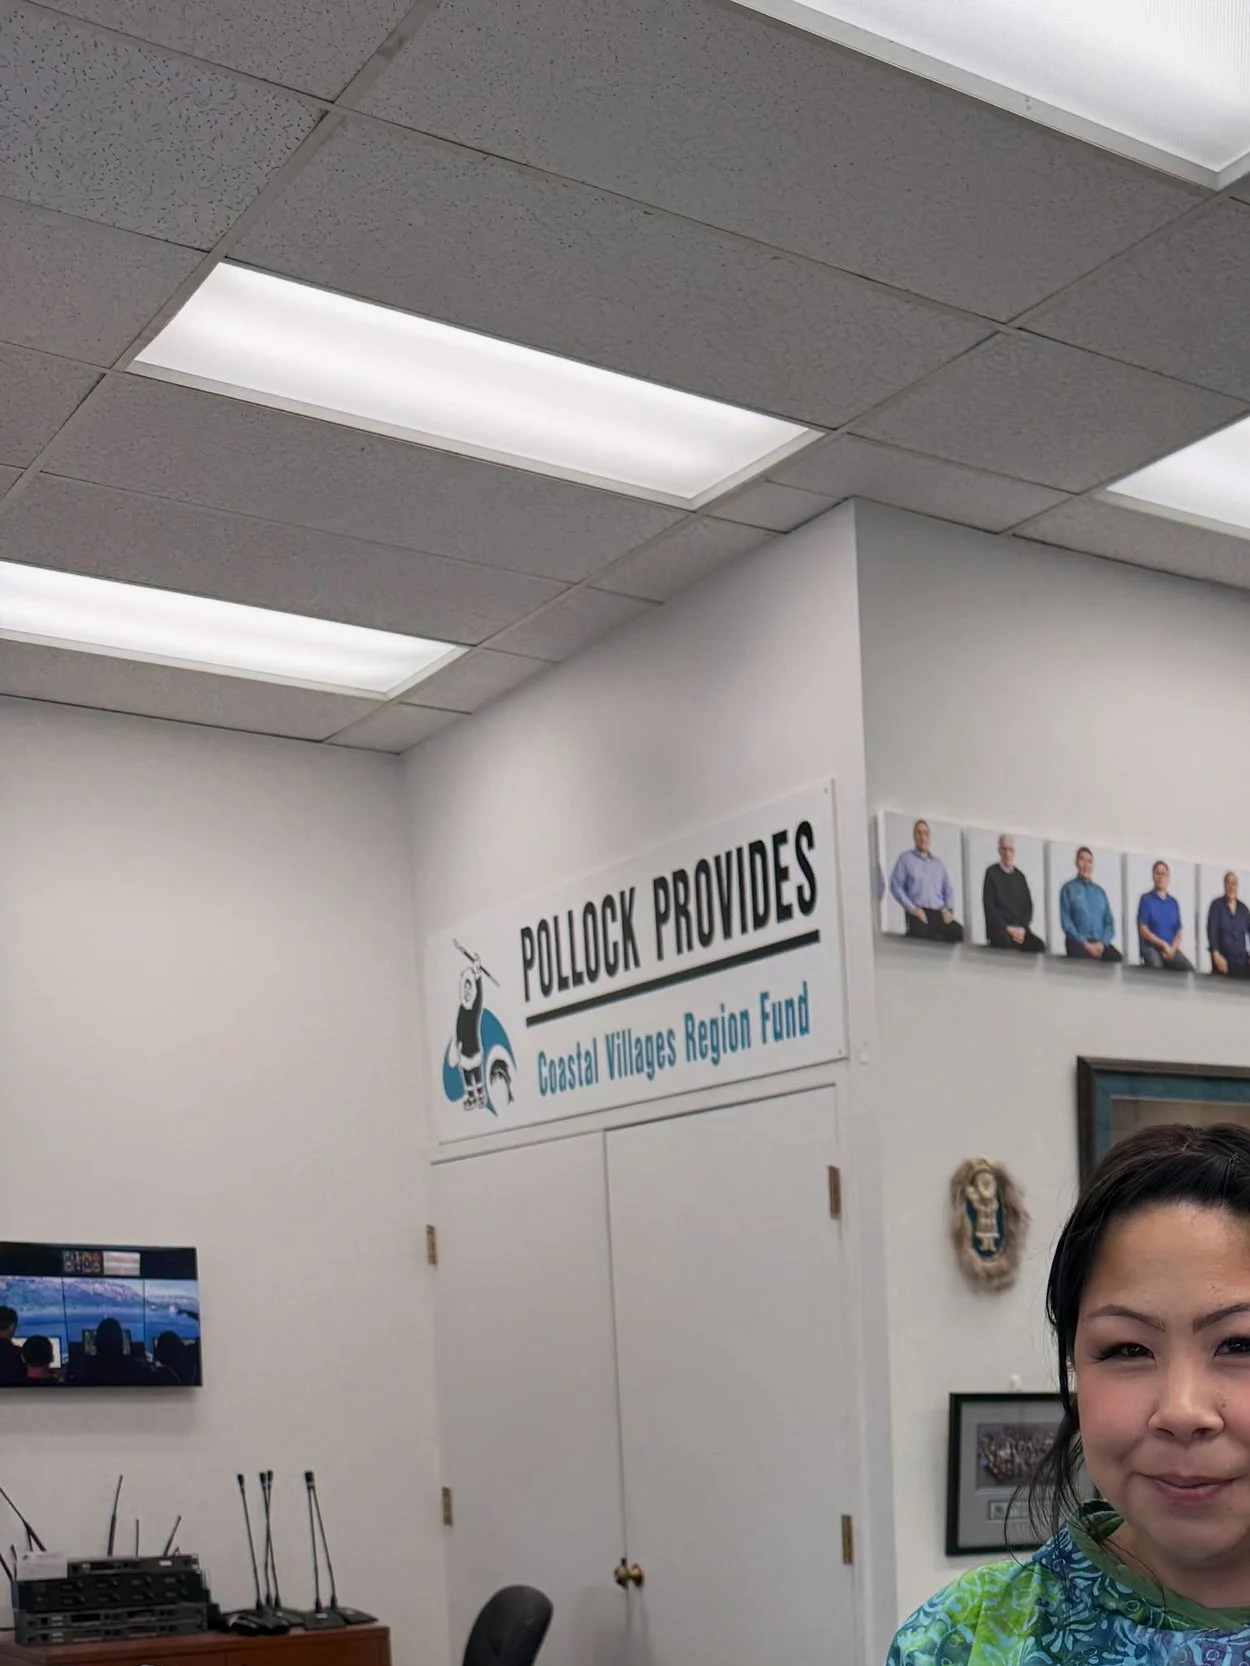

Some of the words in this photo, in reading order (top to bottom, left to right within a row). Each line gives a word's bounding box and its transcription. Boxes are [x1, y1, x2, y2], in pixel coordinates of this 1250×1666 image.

[520, 886, 640, 1002] POLLOCK
[653, 820, 818, 961] PROVIDES
[537, 1037, 599, 1096] Coastal
[605, 1028, 676, 1080] Villages
[684, 1003, 751, 1066] Region
[760, 981, 810, 1045] Fund
